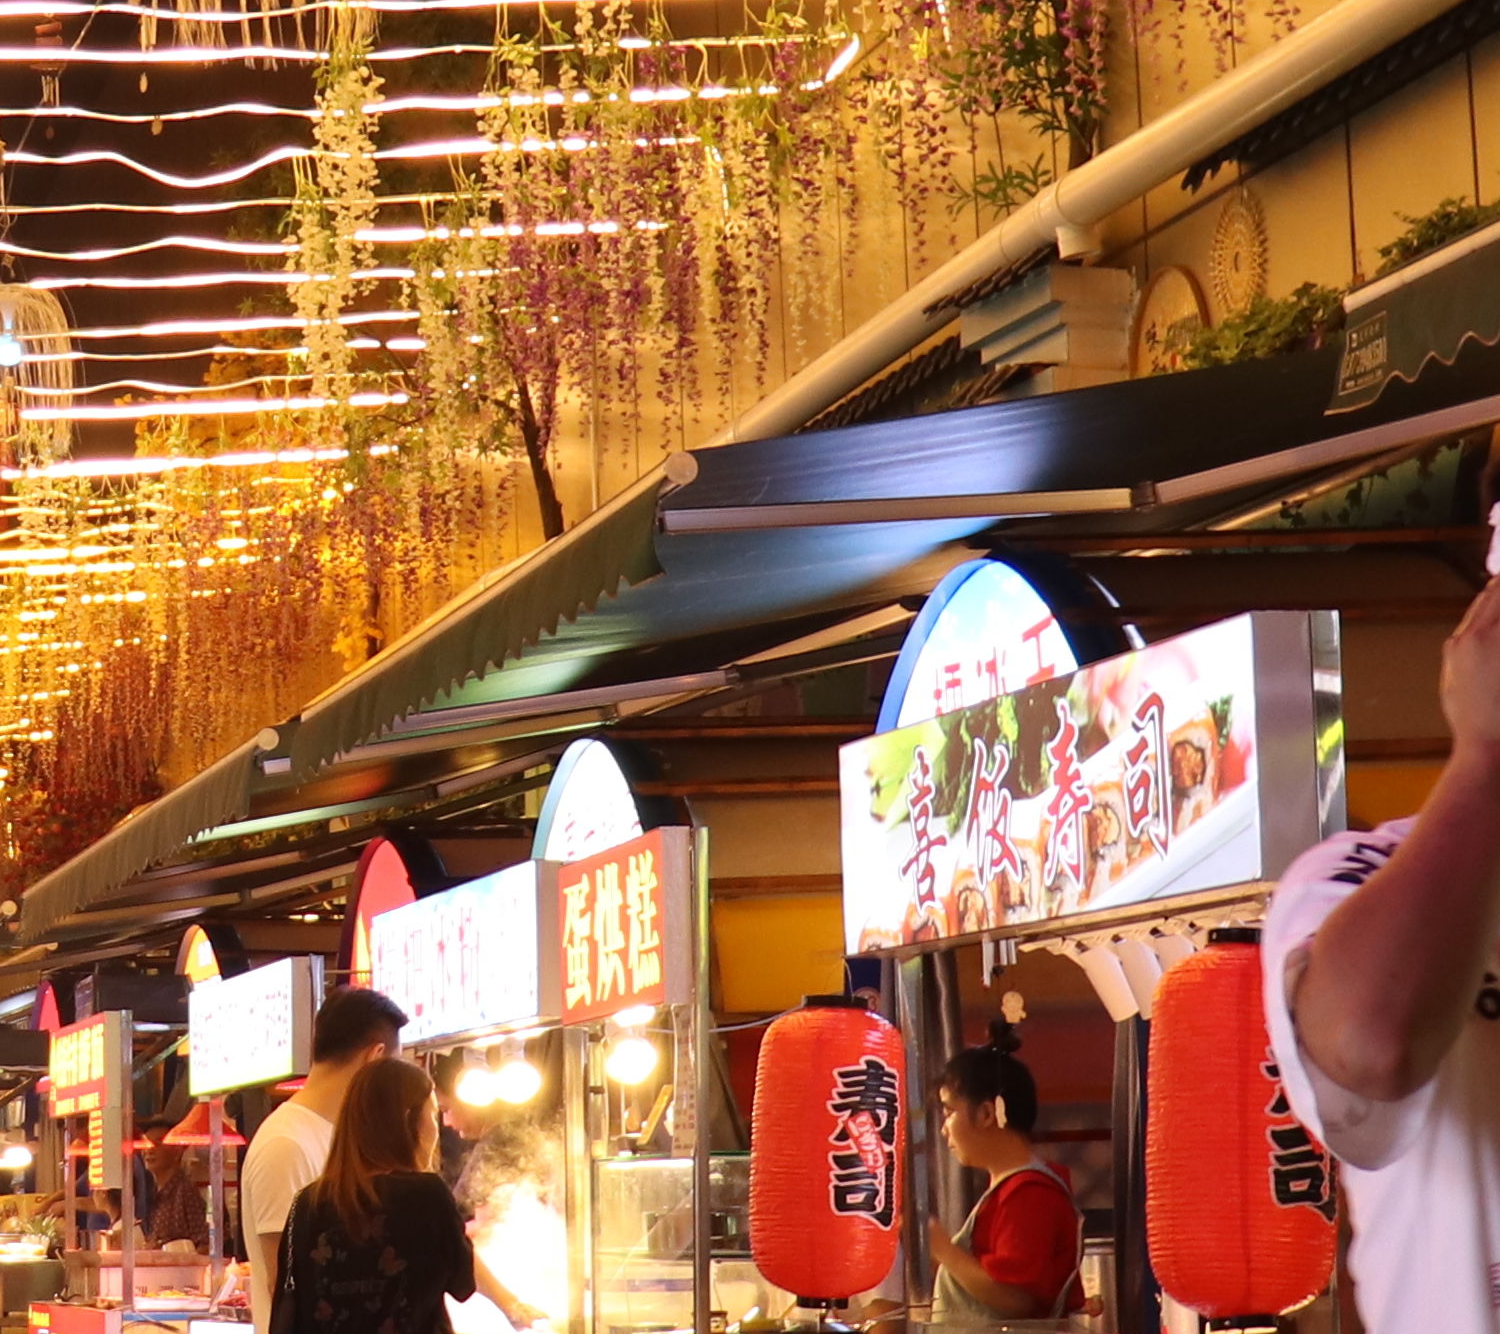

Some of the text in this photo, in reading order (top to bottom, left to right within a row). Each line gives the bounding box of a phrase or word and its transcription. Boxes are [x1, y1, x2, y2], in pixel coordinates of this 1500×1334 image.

[900, 690, 1175, 917] 喜饭寿司
[561, 848, 661, 1011] 蛋烘糕
[826, 1054, 900, 1231] 寿司
[1260, 1045, 1339, 1225] 司
